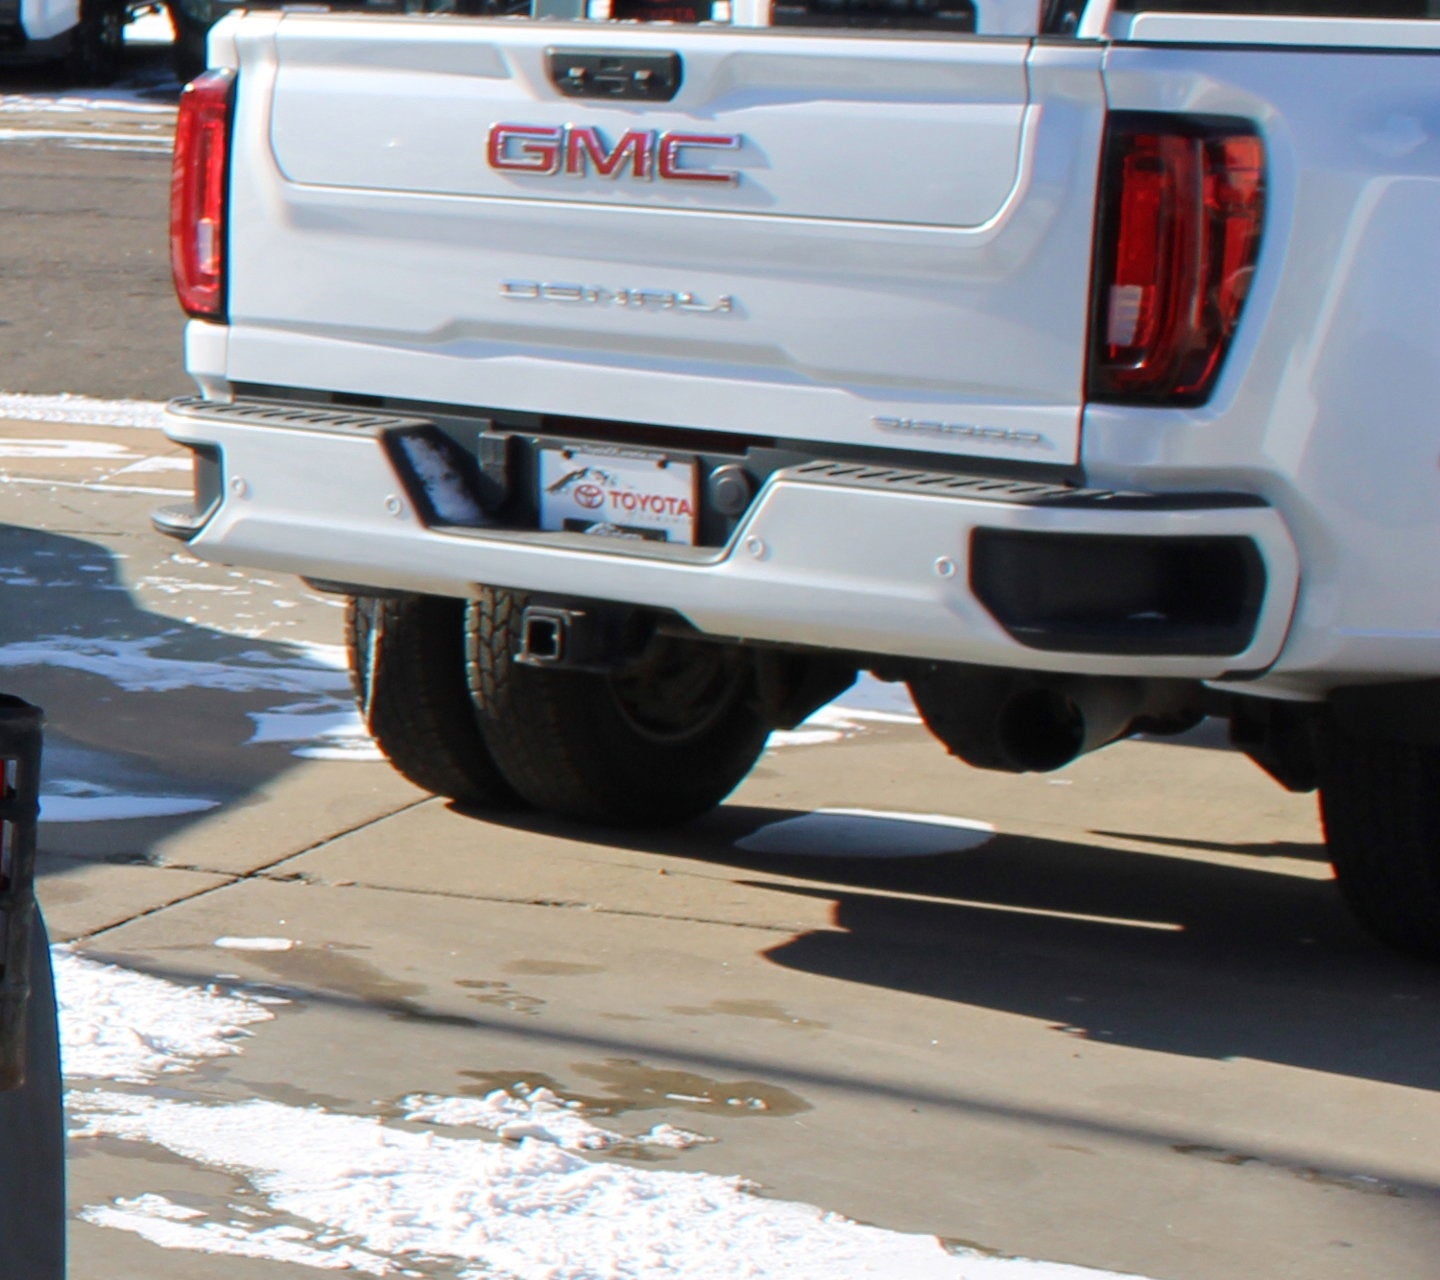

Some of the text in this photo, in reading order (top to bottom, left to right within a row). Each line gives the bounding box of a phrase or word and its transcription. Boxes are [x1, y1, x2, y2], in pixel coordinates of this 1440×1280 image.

[486, 121, 742, 188] GMC
[499, 278, 733, 312] DENALI
[607, 490, 695, 518] TOYOTA
